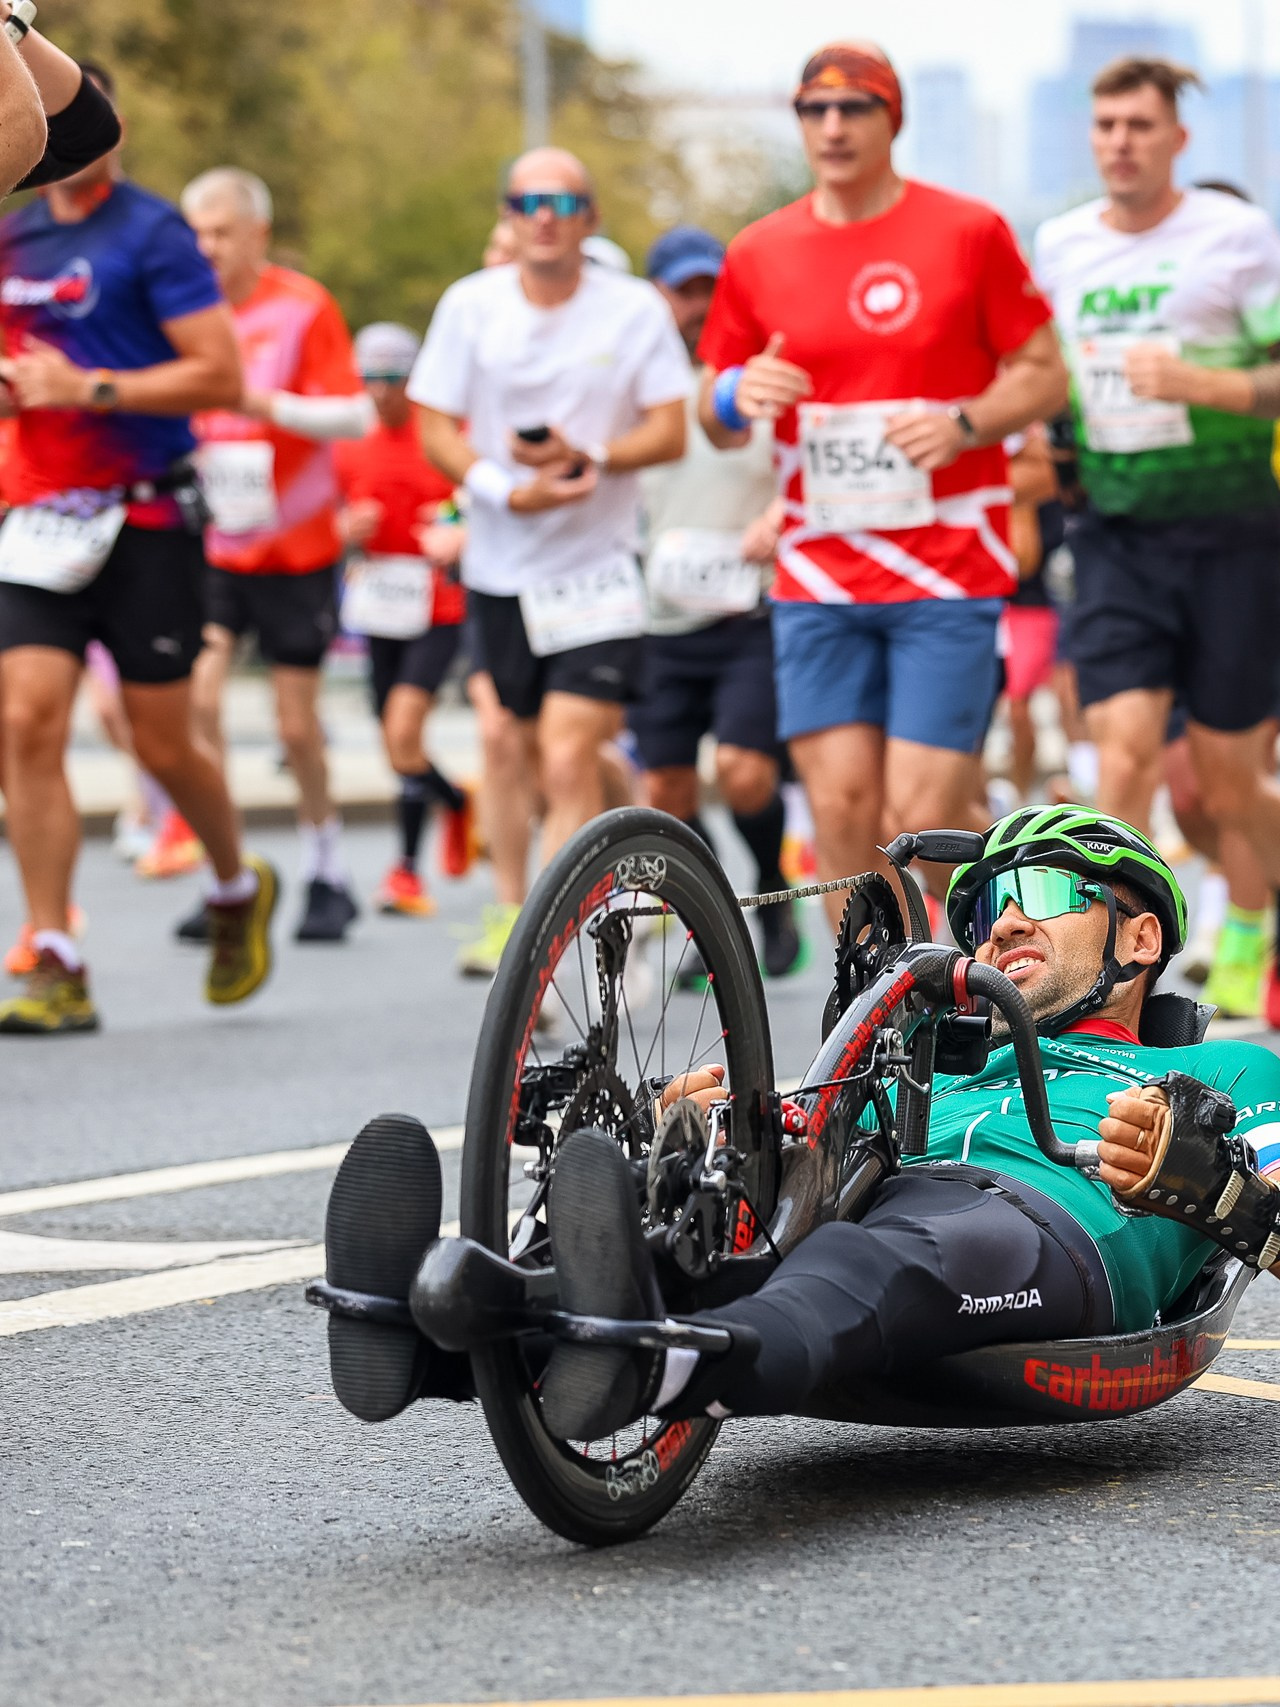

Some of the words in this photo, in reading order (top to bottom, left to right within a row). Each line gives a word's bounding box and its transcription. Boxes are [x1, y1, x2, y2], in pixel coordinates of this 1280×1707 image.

[807, 435, 915, 477] 1554
[957, 1287, 1043, 1315] ARMADA
[1023, 1336, 1208, 1412] carbonbike
